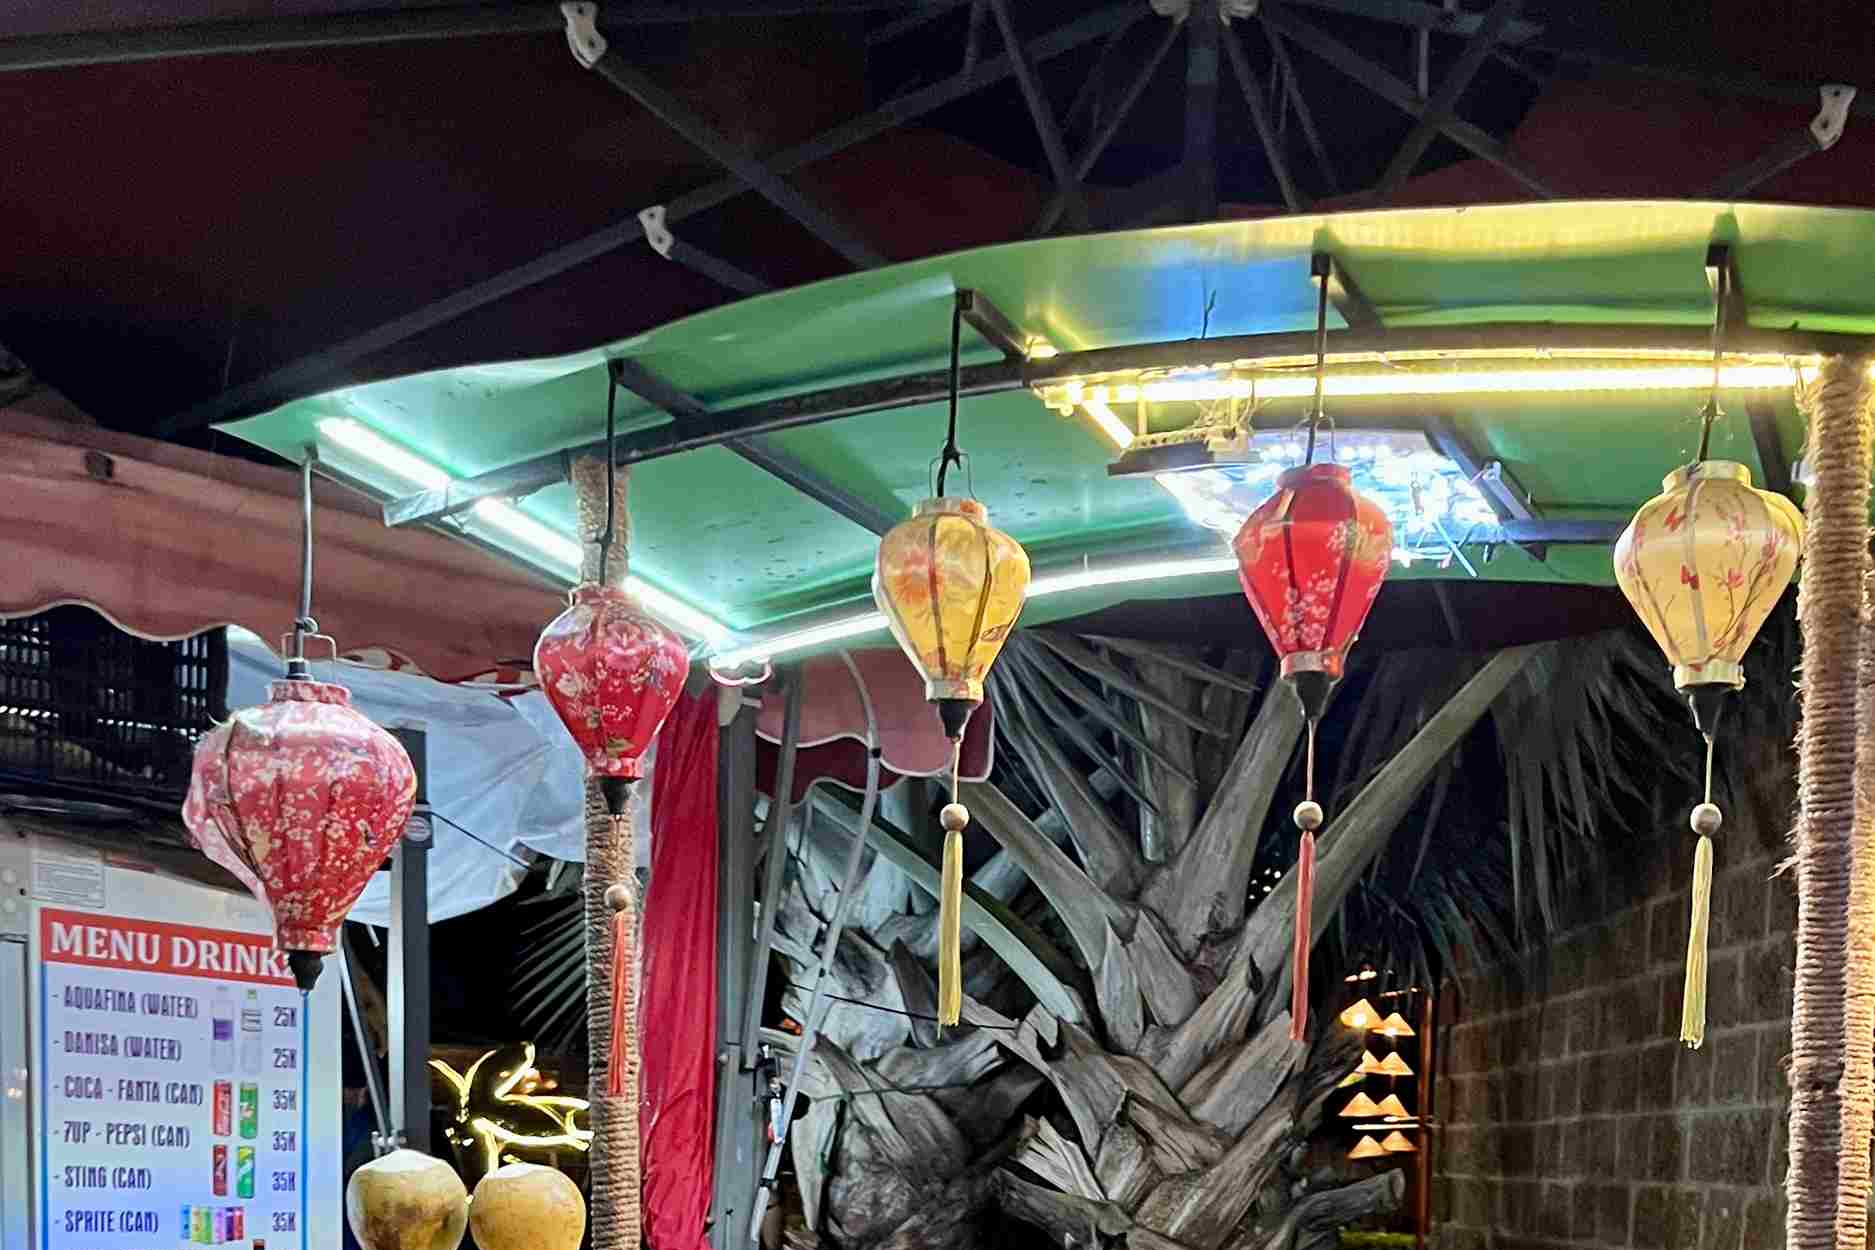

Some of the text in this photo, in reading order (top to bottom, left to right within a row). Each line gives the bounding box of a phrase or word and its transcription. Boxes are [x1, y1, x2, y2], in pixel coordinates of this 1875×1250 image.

[50, 921, 160, 965] MENU
[64, 985, 297, 1027] AQUAFINA (WATER) 25K
[124, 1036, 182, 1061] (WATER)
[273, 1048, 297, 1069] 25K
[64, 1076, 103, 1100] COCA
[118, 1079, 160, 1103] FANTA
[166, 1082, 203, 1106] (CAN)
[272, 1089, 297, 1110] 35K
[63, 1120, 91, 1144] 7UP
[106, 1123, 146, 1146] PEPSI
[151, 1125, 190, 1148] (CAN)
[272, 1131, 296, 1152] 35K
[64, 1166, 296, 1192] STING (CAN) 35K
[64, 1210, 115, 1233] SPRITE
[120, 1210, 159, 1233] (CAN)
